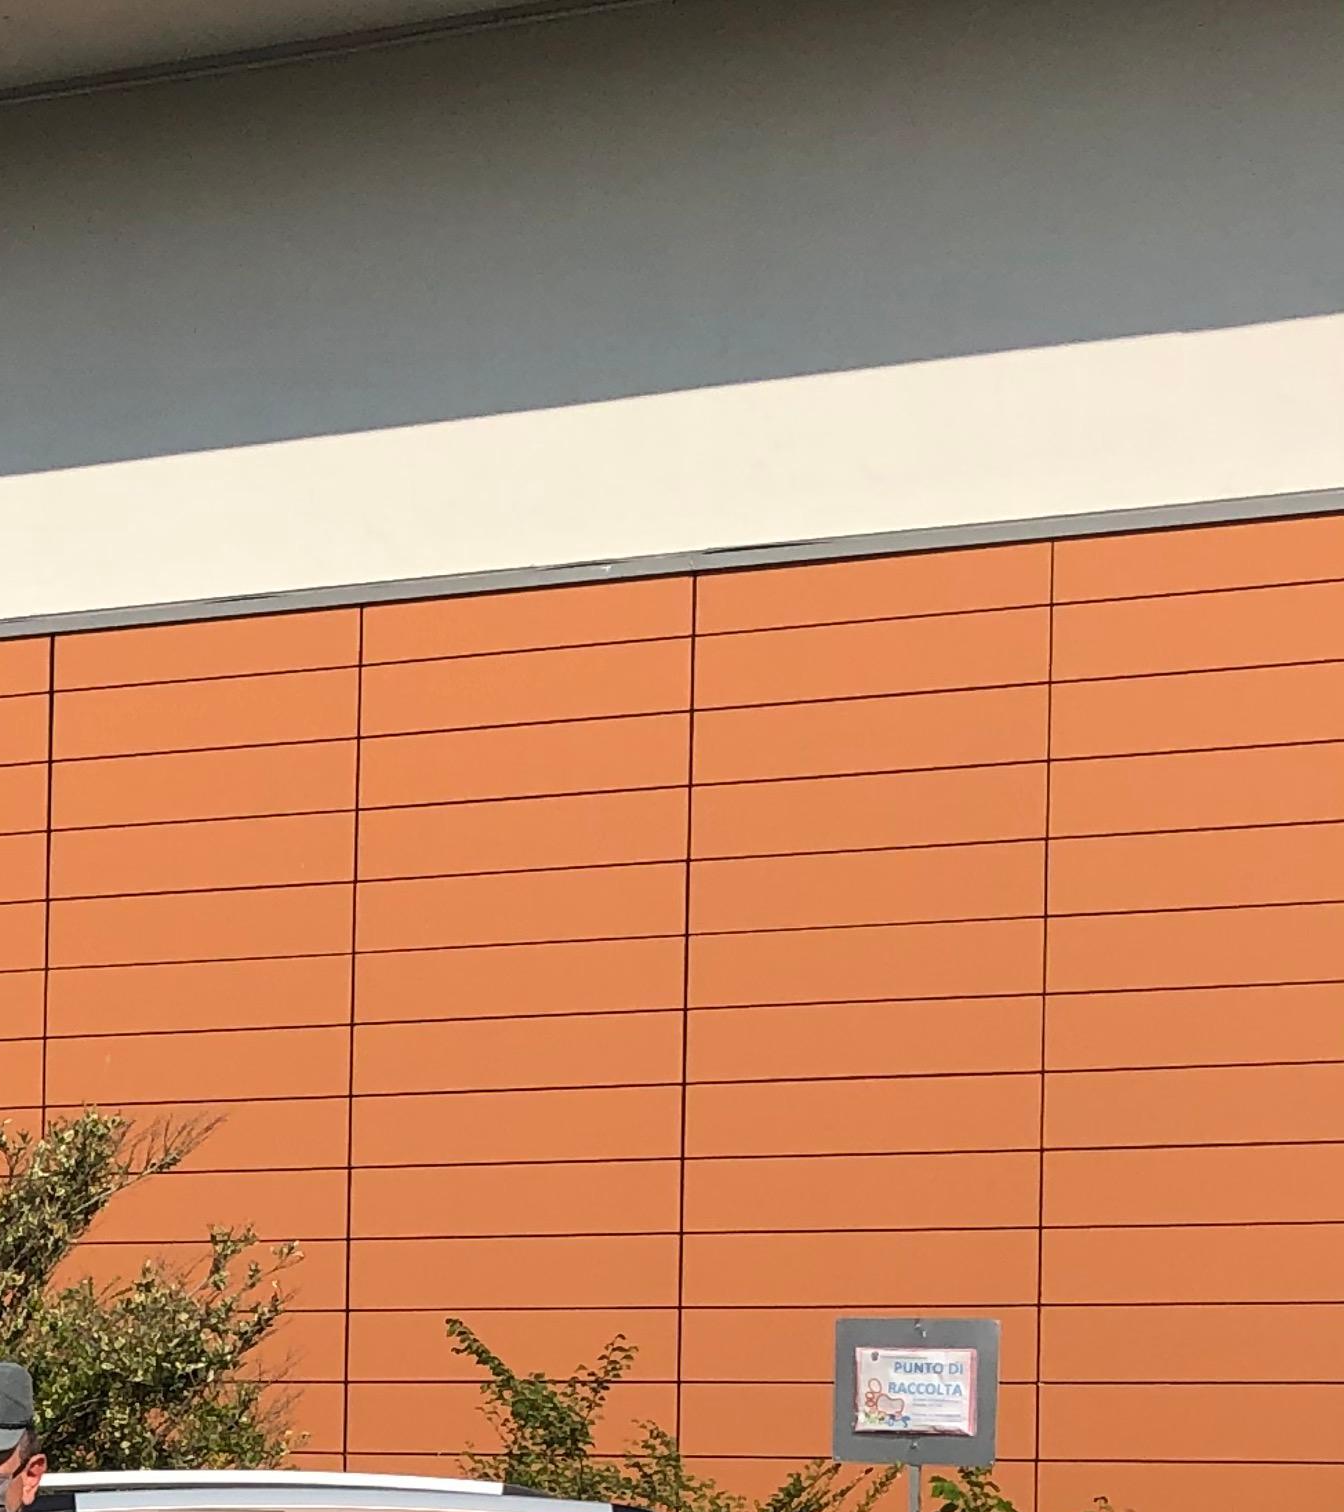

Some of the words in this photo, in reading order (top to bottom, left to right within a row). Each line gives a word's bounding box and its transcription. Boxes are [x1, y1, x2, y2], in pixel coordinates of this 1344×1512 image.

[894, 1361, 944, 1374] PUNTO
[948, 1362, 963, 1374] DI
[888, 1382, 963, 1396] RACCOLTA
